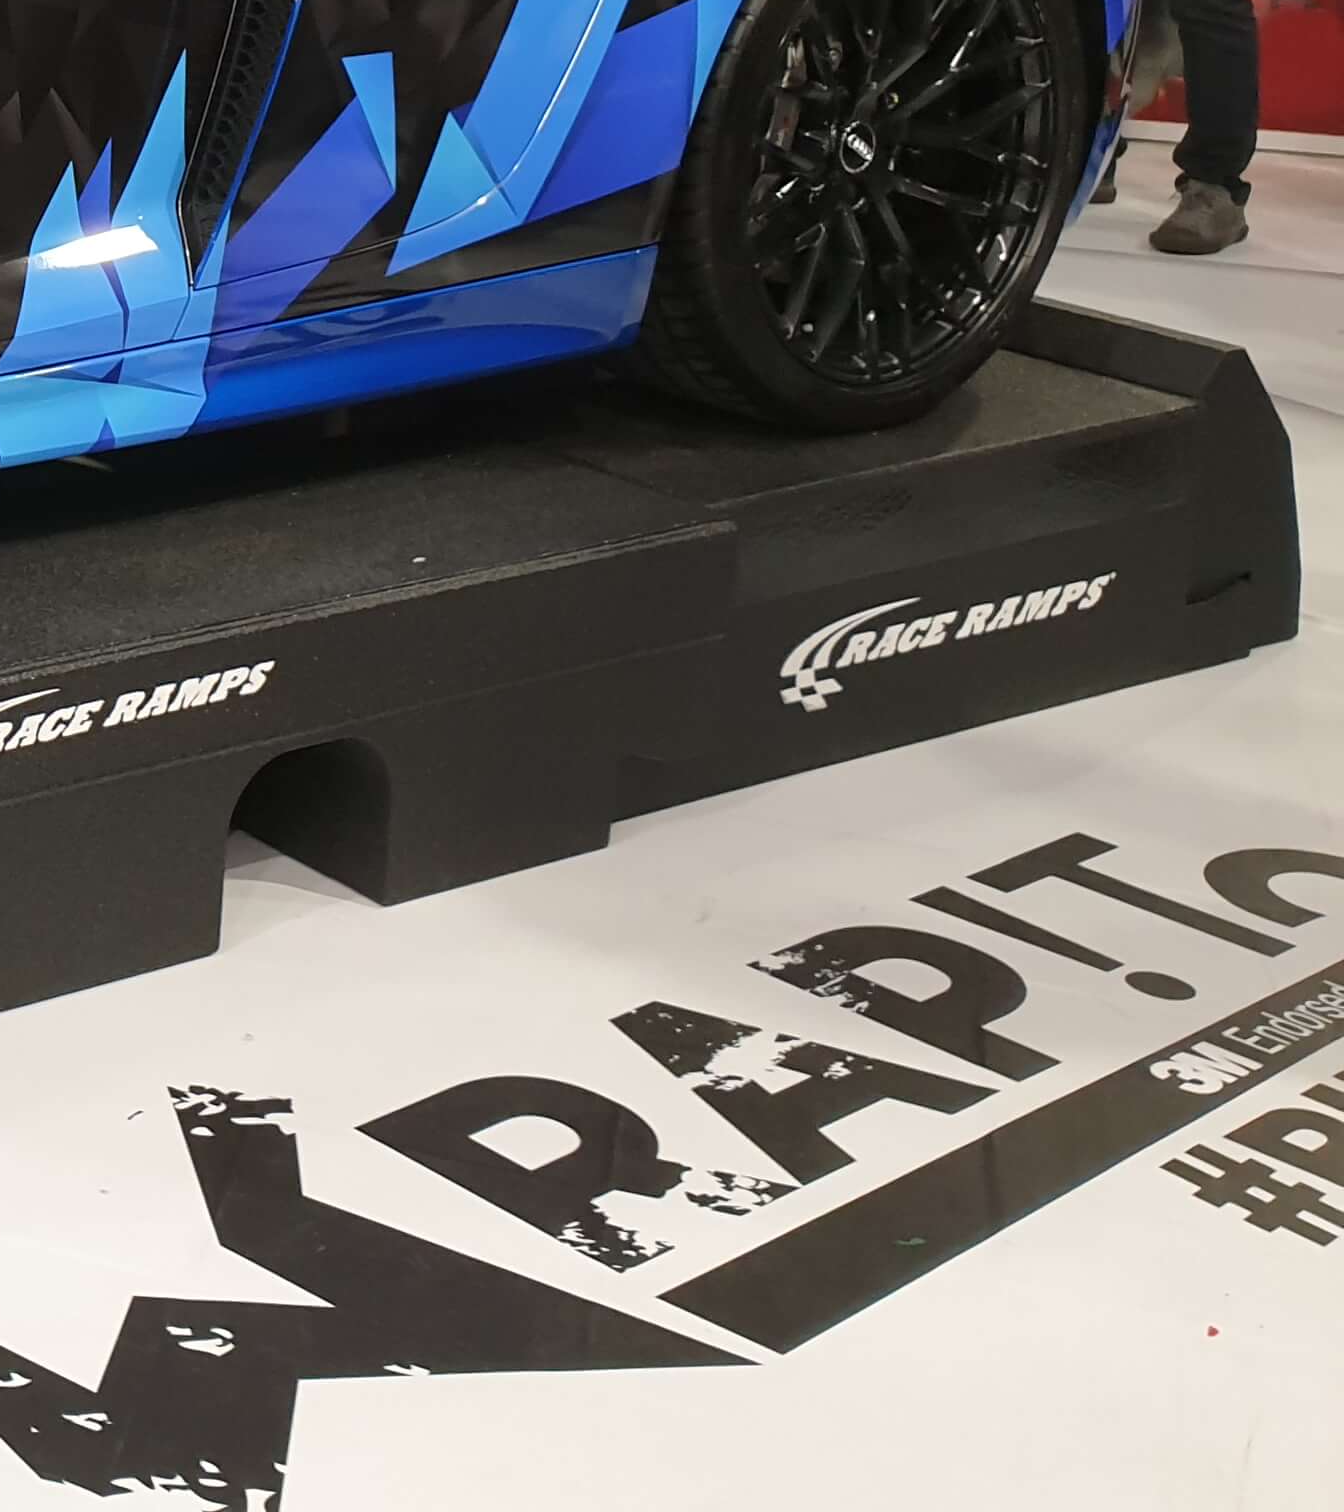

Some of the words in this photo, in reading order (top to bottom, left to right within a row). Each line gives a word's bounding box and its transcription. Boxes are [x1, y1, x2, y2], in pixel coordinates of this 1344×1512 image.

[835, 610, 959, 668] RACE
[956, 572, 1112, 640] RAMPS
[103, 659, 276, 728] RAMPS
[1149, 1040, 1265, 1096] 3M
